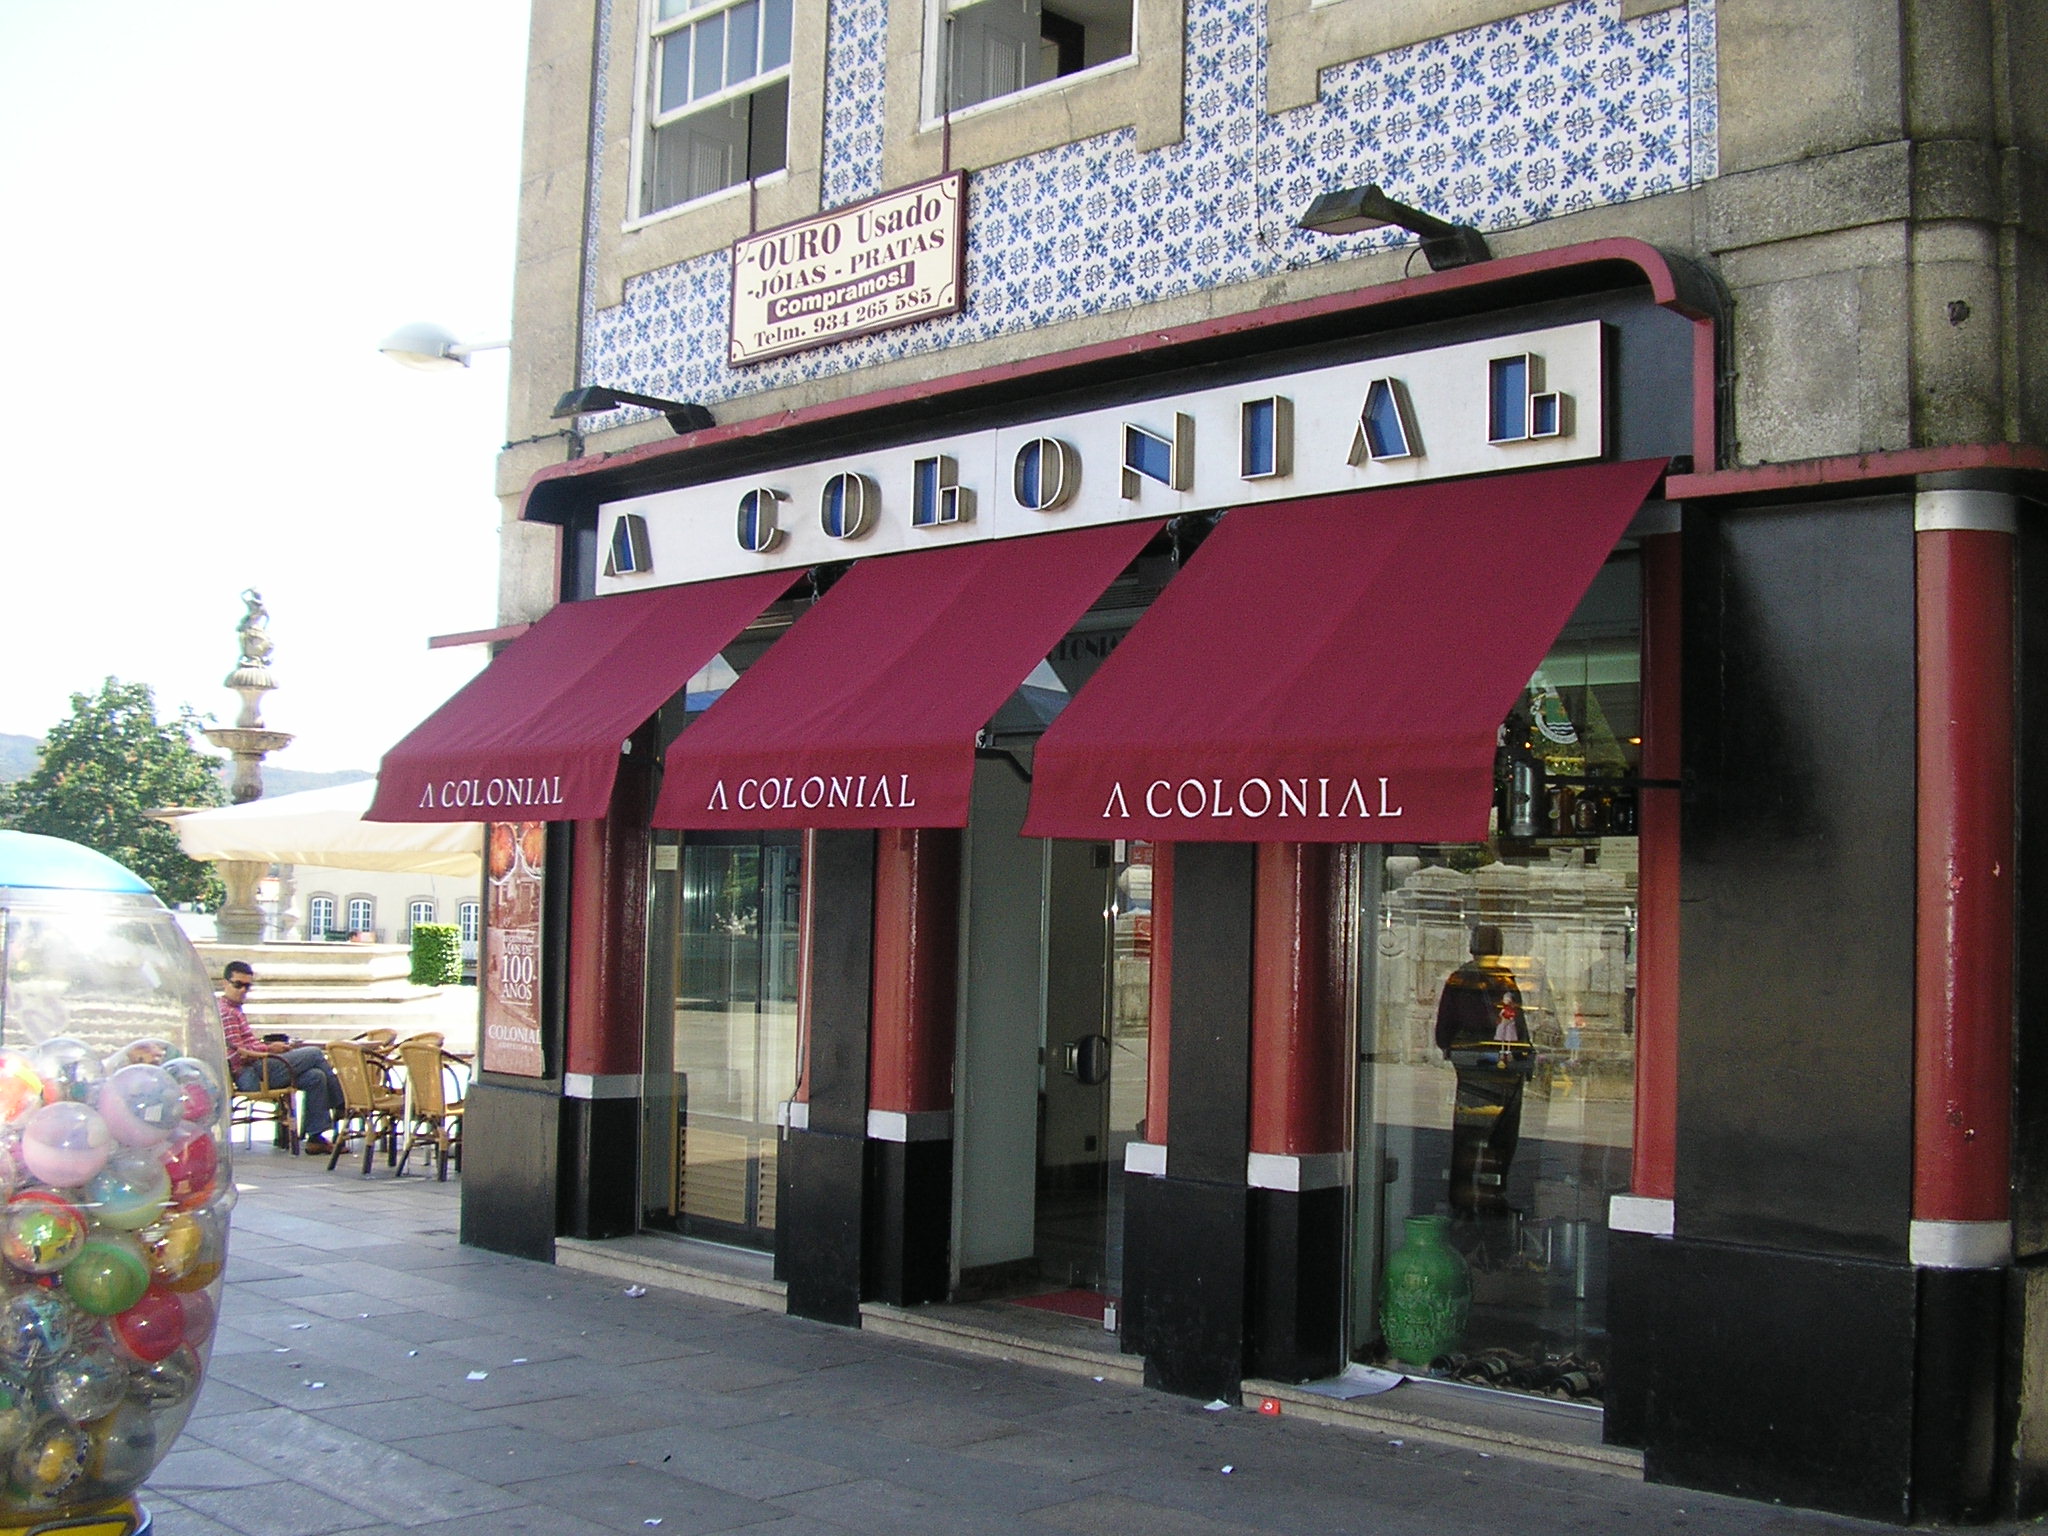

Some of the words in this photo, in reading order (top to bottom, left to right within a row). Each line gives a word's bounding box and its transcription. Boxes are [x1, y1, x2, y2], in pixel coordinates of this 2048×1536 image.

[856, 194, 942, 244] Usado
[850, 228, 945, 274] PRATAS
[775, 265, 907, 318] Compramos!
[754, 325, 806, 348] Telm.
[813, 311, 849, 334] 934
[856, 300, 888, 323] 265
[895, 287, 932, 311] 585
[602, 512, 653, 577] A
[735, 350, 1569, 553] COLONIAL
[418, 782, 435, 809] A
[441, 776, 564, 808] COLONIAL
[707, 780, 729, 810] A
[738, 774, 916, 810] COLONIAL
[1102, 781, 1130, 818] A
[1146, 777, 1403, 818] COLONIAL
[502, 955, 533, 984] 100
[501, 983, 533, 1000] ANOS
[488, 1024, 542, 1044] COLONIAL
